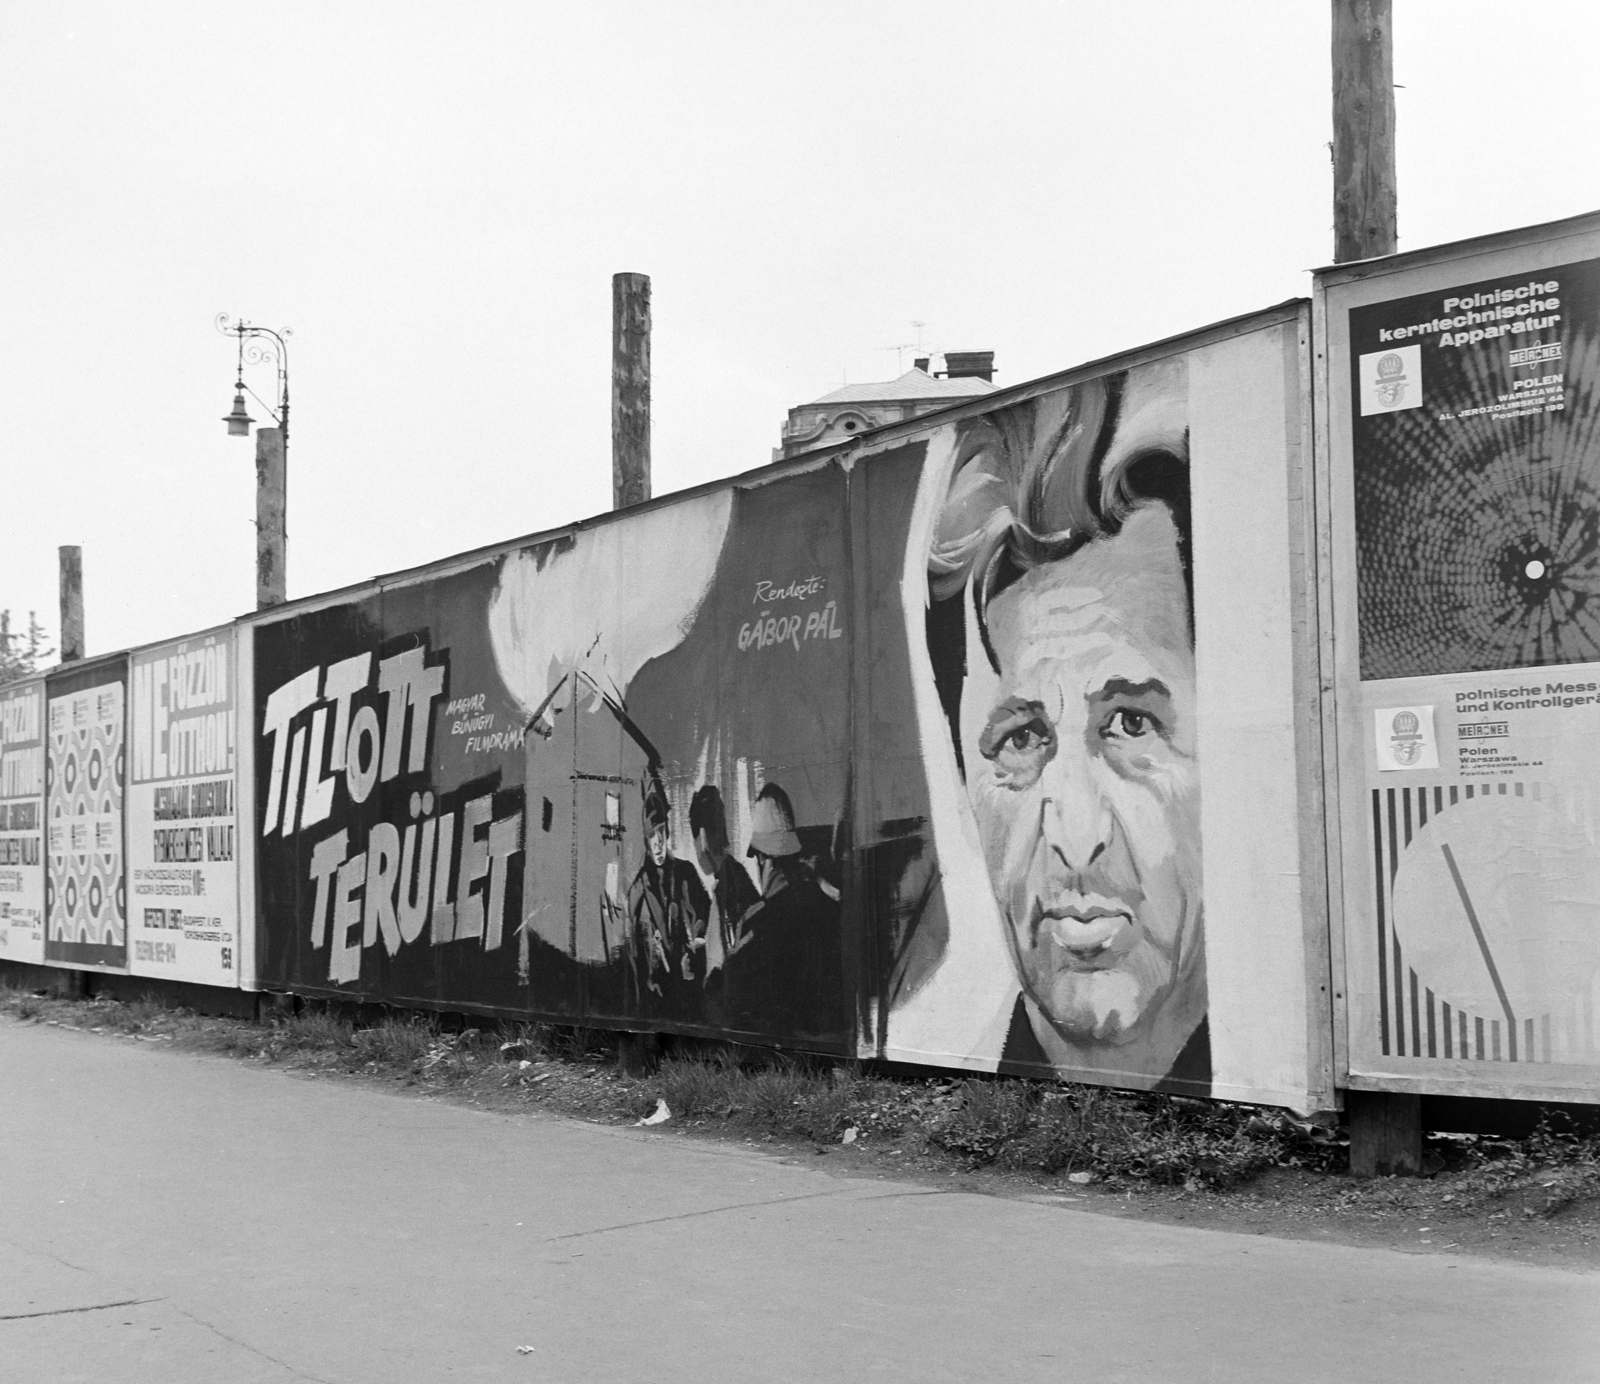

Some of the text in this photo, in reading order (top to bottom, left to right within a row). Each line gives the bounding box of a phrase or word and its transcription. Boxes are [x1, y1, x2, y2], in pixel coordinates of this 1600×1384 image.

[1443, 280, 1560, 313] Polnische
[1379, 297, 1561, 342] kerntechnische
[1439, 314, 1561, 347] Apparatur
[1509, 343, 1562, 366] METRONEX
[1497, 385, 1564, 402] WARSZAWA
[1513, 374, 1563, 391] POLEN
[1439, 394, 1564, 421] AL. JEROZOLIMSKIE 44
[737, 600, 843, 652] GÁBOR PÁL
[445, 693, 486, 716] MAGYAR
[1455, 686, 1541, 702] polnische
[1456, 701, 1489, 713] und
[464, 724, 526, 754] FILMDRÁMA
[1459, 747, 1498, 756] Polen
[1459, 755, 1518, 763] Warszawa
[309, 790, 523, 985] TERÜLET
